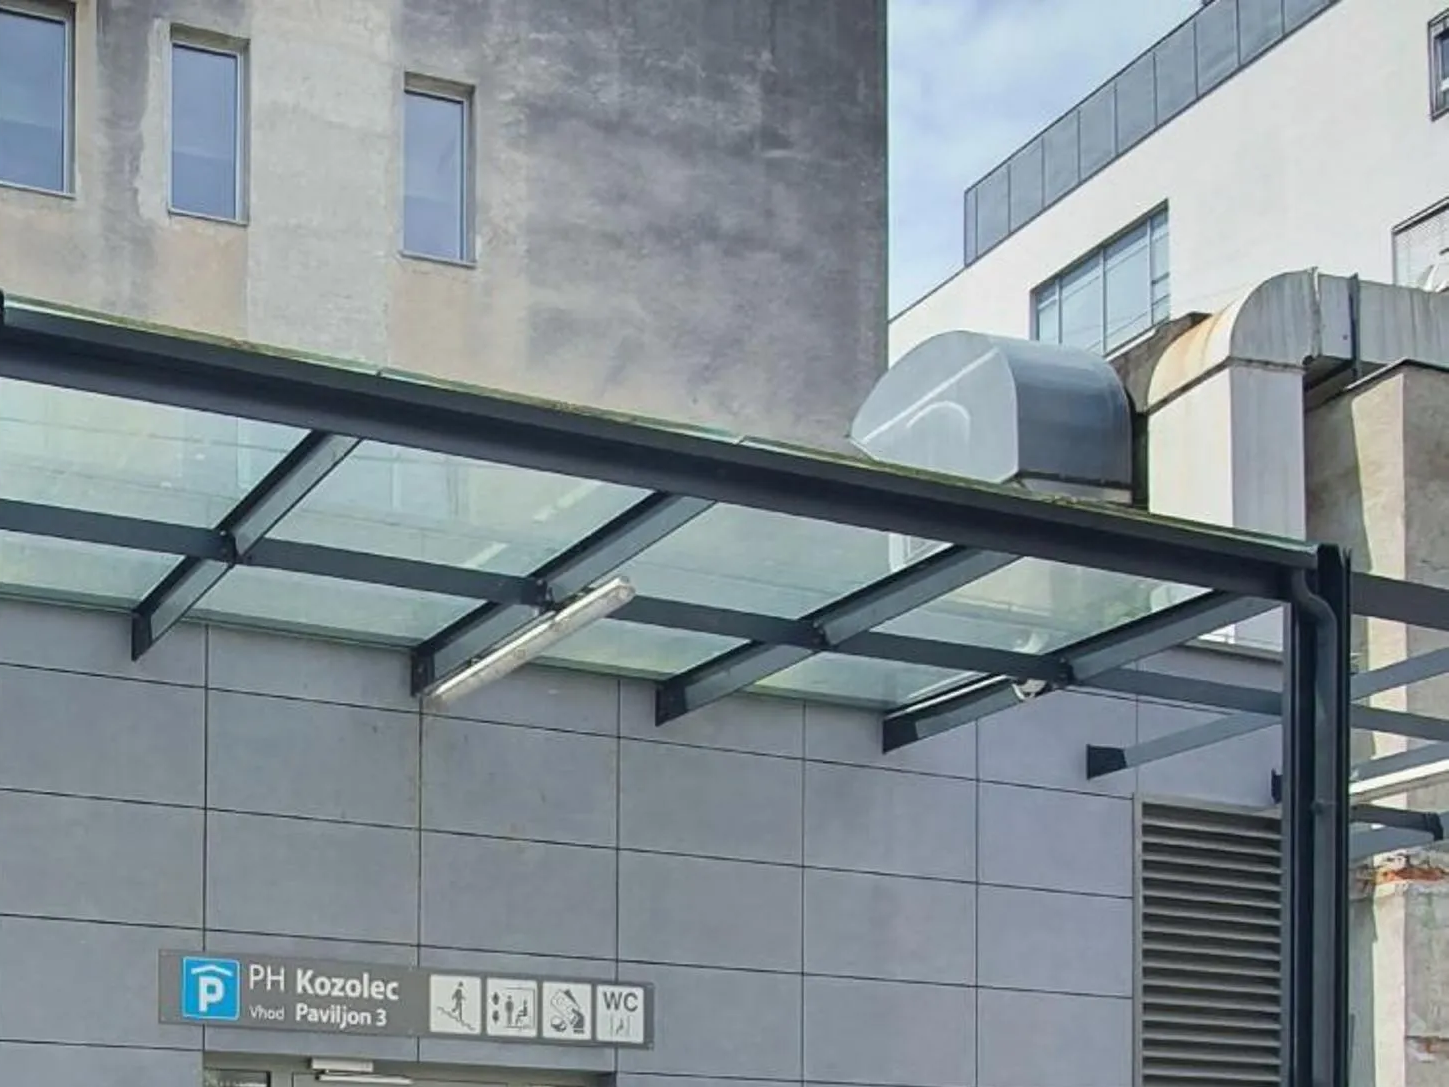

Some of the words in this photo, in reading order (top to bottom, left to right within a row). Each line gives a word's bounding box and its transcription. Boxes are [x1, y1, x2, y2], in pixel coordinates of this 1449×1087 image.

[198, 976, 225, 1012] P
[249, 964, 285, 991] PH
[296, 968, 400, 1000] Kozolec
[249, 1005, 285, 1021] Vhod
[295, 1003, 372, 1029] Paviljon
[376, 1009, 387, 1027] 3
[603, 991, 638, 1012] WC
